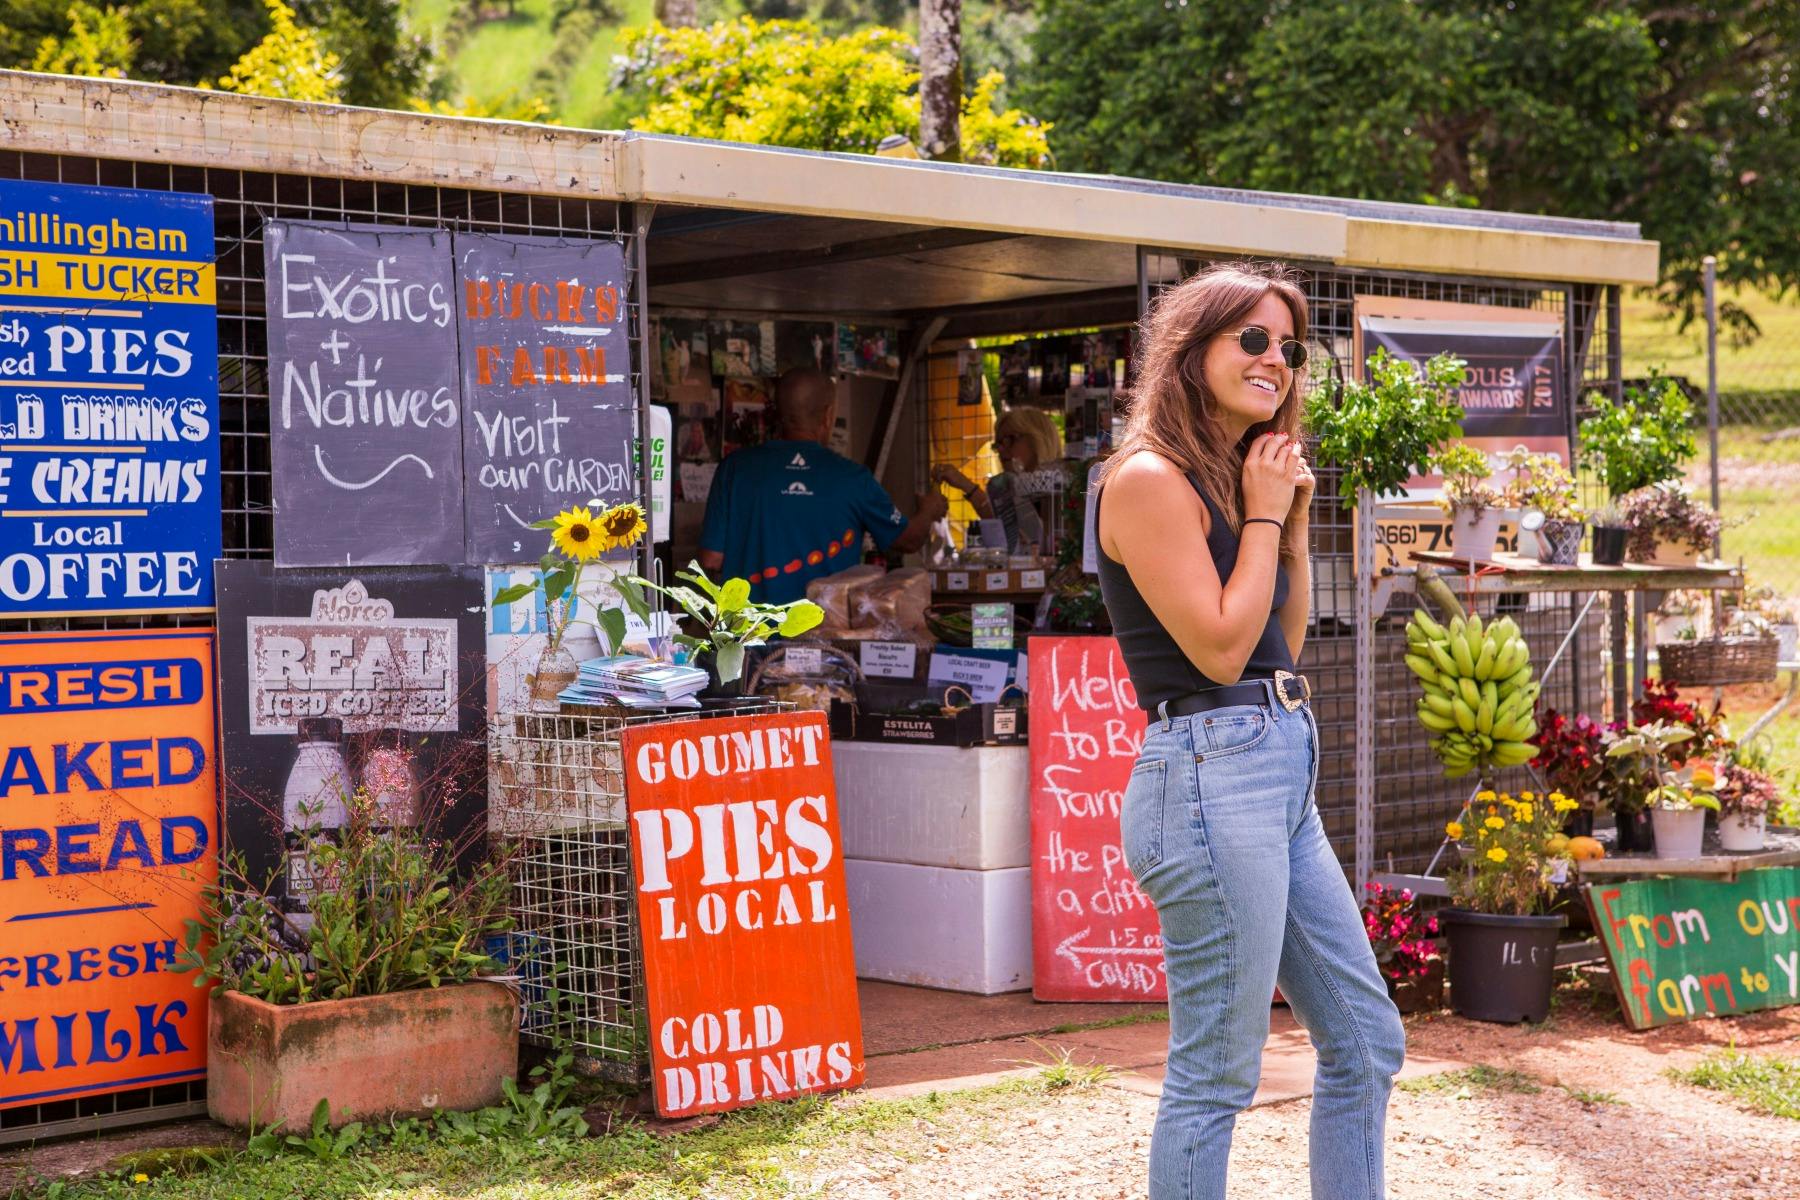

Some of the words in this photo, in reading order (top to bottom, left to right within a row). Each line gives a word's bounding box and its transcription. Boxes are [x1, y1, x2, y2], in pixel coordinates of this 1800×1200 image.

[57, 262, 200, 296] TUCKER
[281, 253, 451, 328] Exotics
[0, 352, 36, 376] ed
[44, 325, 193, 377] PIES
[475, 345, 608, 385] FARM
[283, 353, 458, 429] Natives
[1458, 389, 1524, 409] AWARDS
[1533, 364, 1552, 408] 2017
[62, 395, 210, 442] DRINKS
[31, 457, 207, 504] CREAMS
[479, 462, 540, 491] our
[544, 440, 631, 496] GARDEN
[33, 521, 123, 546] Local
[0, 551, 201, 601] OFFEE
[316, 595, 389, 624] Norco
[0, 665, 183, 708] RESH
[262, 636, 447, 691] REAL
[263, 692, 328, 718] ICED
[884, 720, 933, 730] ESTELITA
[637, 725, 823, 784] GOUMET
[882, 729, 935, 739] STRAWBERRIES
[1050, 711, 1100, 760] to
[0, 736, 206, 797] AKED
[0, 815, 209, 880] READ
[634, 795, 833, 892] PIES
[1041, 831, 1093, 873] the
[658, 880, 836, 940] LOCAL
[1057, 889, 1083, 916] a
[1601, 888, 1710, 952] From
[1740, 966, 1770, 993] to
[0, 1000, 189, 1074] MILK
[660, 1004, 784, 1060] COLD
[663, 1041, 853, 1111] DRINKS
